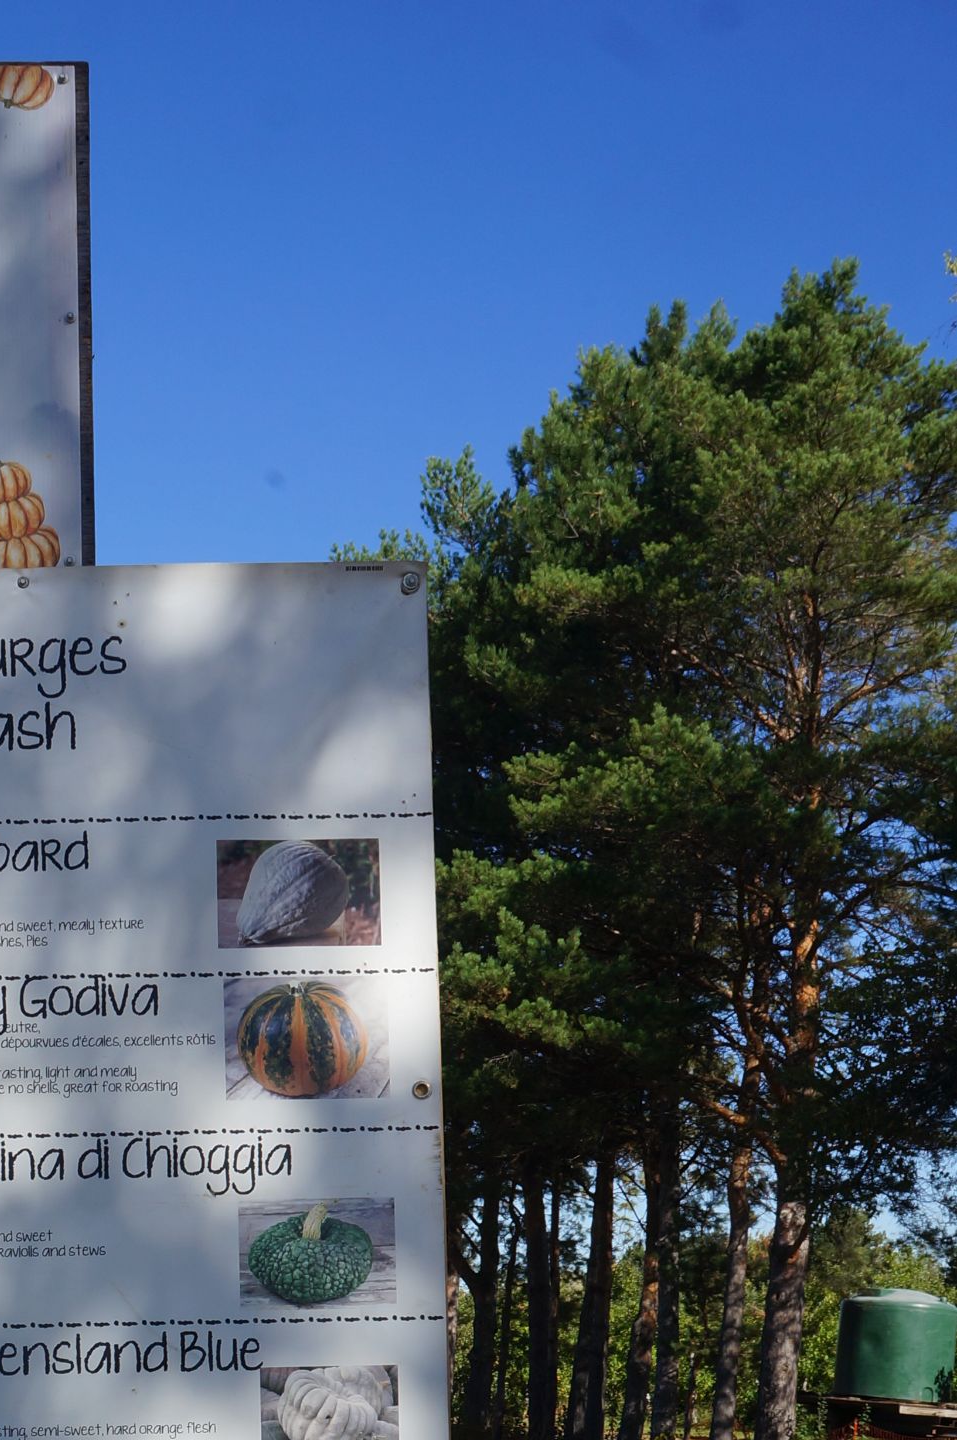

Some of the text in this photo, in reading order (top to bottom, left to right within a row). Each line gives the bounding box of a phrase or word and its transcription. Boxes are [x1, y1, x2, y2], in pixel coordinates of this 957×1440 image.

[20, 975, 159, 1019] Godiva
[78, 1138, 110, 1179] di
[122, 1136, 293, 1196] Chioggia
[180, 1330, 264, 1372] Blue
